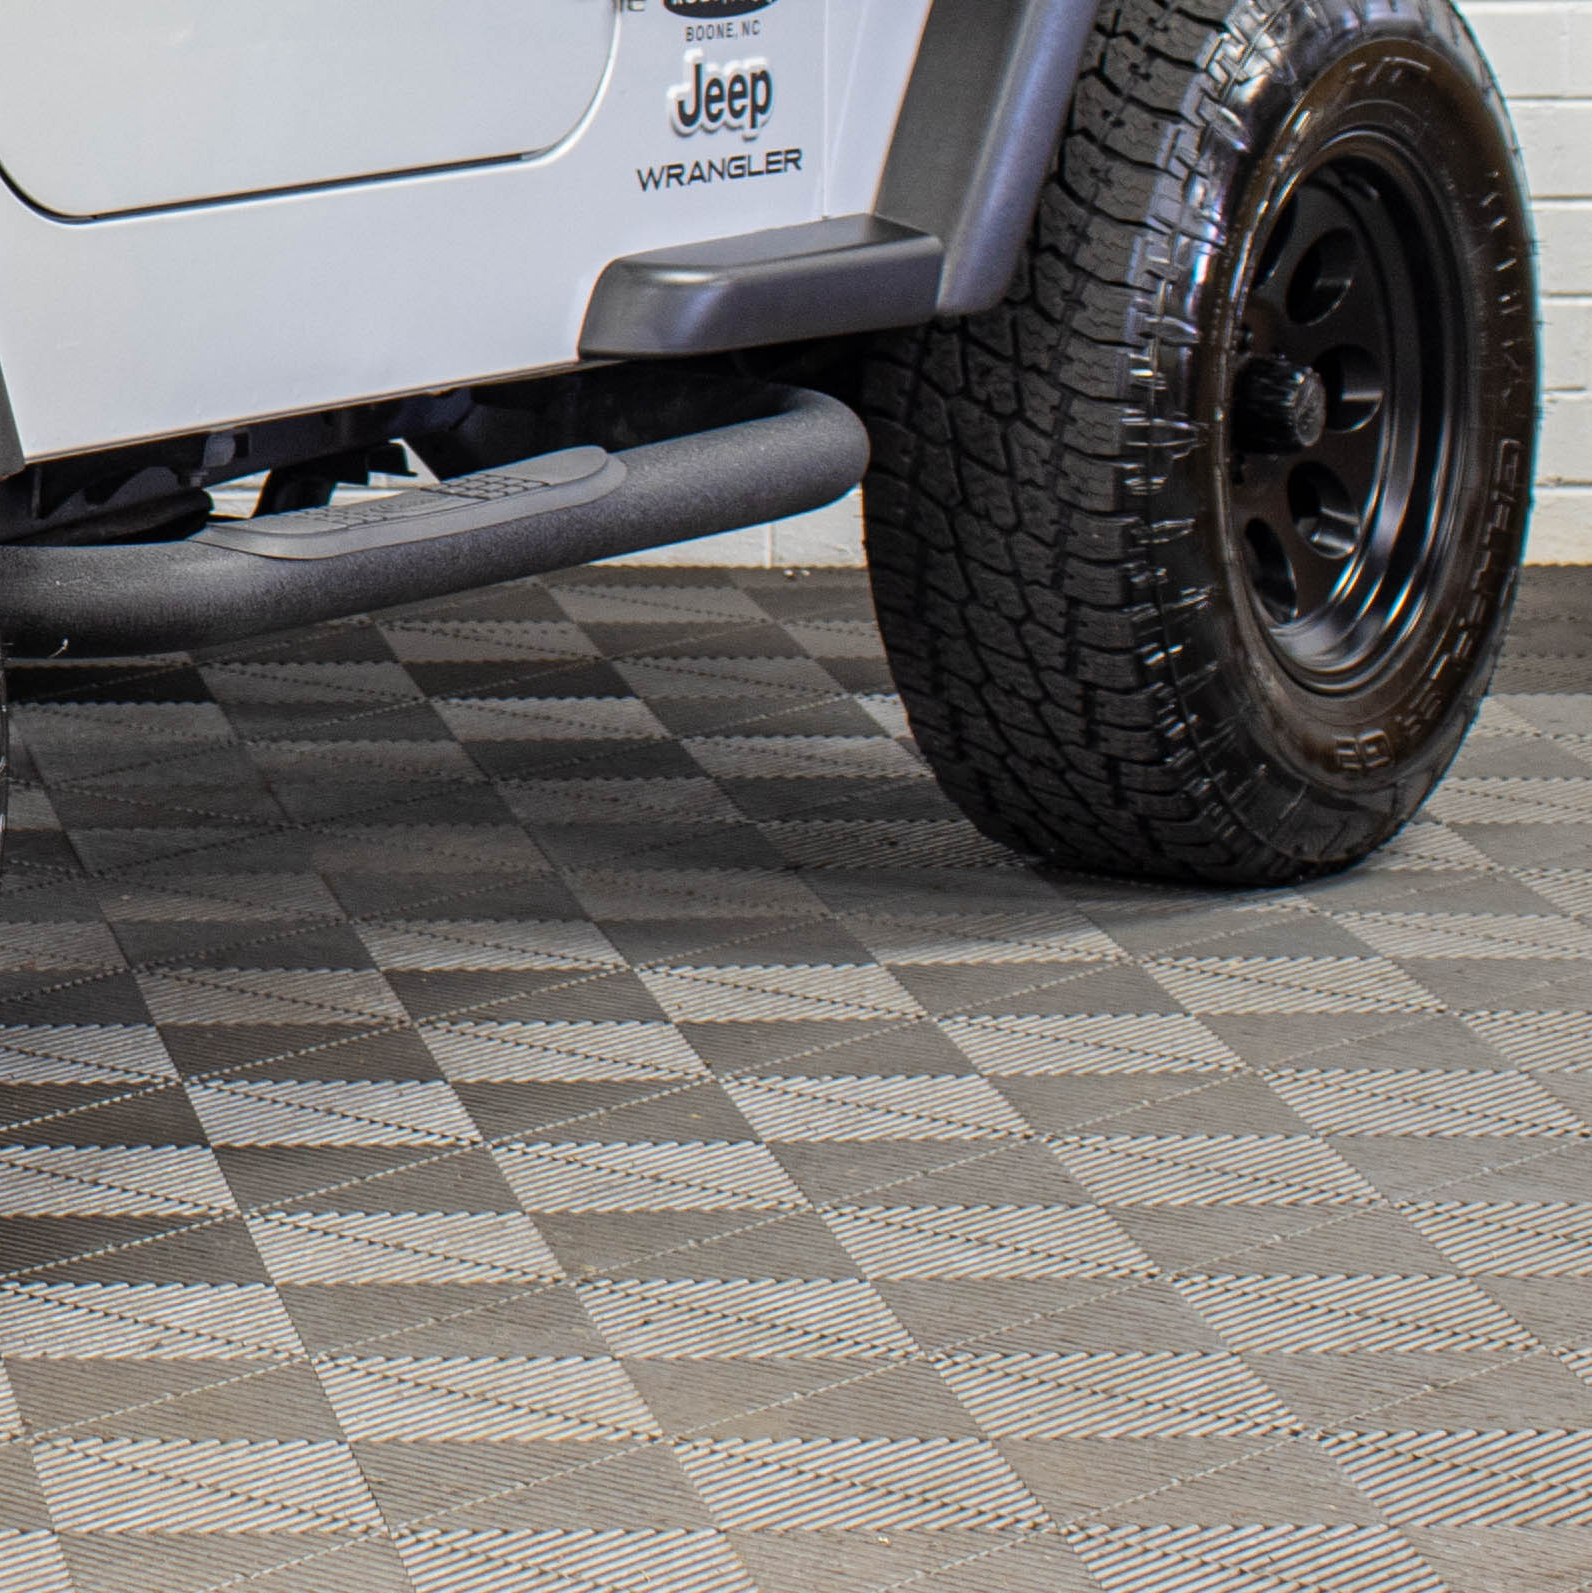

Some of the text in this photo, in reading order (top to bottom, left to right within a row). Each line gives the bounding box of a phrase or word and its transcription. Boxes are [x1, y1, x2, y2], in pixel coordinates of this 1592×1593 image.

[741, 19, 761, 36] NC
[672, 56, 774, 134] Jeep
[637, 148, 803, 192] WRANGLER
